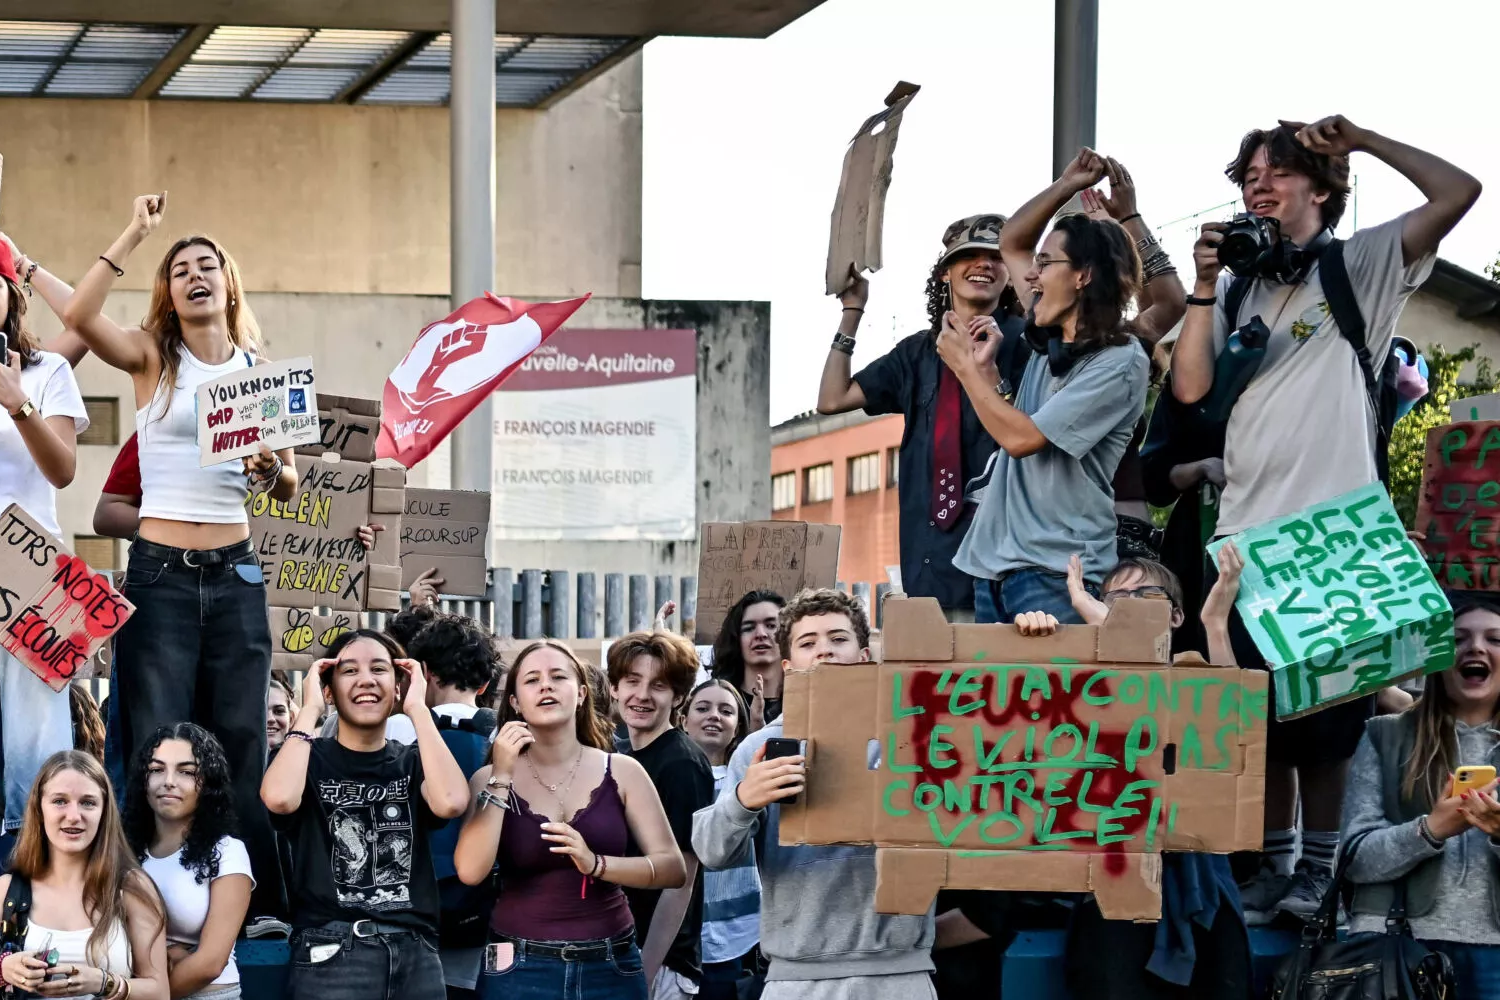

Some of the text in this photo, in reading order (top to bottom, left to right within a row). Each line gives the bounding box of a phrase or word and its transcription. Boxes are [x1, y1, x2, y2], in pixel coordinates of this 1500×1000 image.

[208, 384, 238, 408] YOU
[239, 375, 285, 396] KNOW
[207, 407, 234, 429] BAD
[236, 403, 258, 415] WHEN
[504, 420, 577, 438] FRANÇOIS
[580, 421, 656, 436] MAGENDIE
[300, 464, 344, 491] AVEC
[502, 470, 654, 486] FRANÇOIS MAGENDIE
[259, 531, 277, 556] LE
[281, 533, 314, 557] PEN
[0, 513, 129, 630] TJRS NOTÉS
[887, 725, 958, 773] LE
